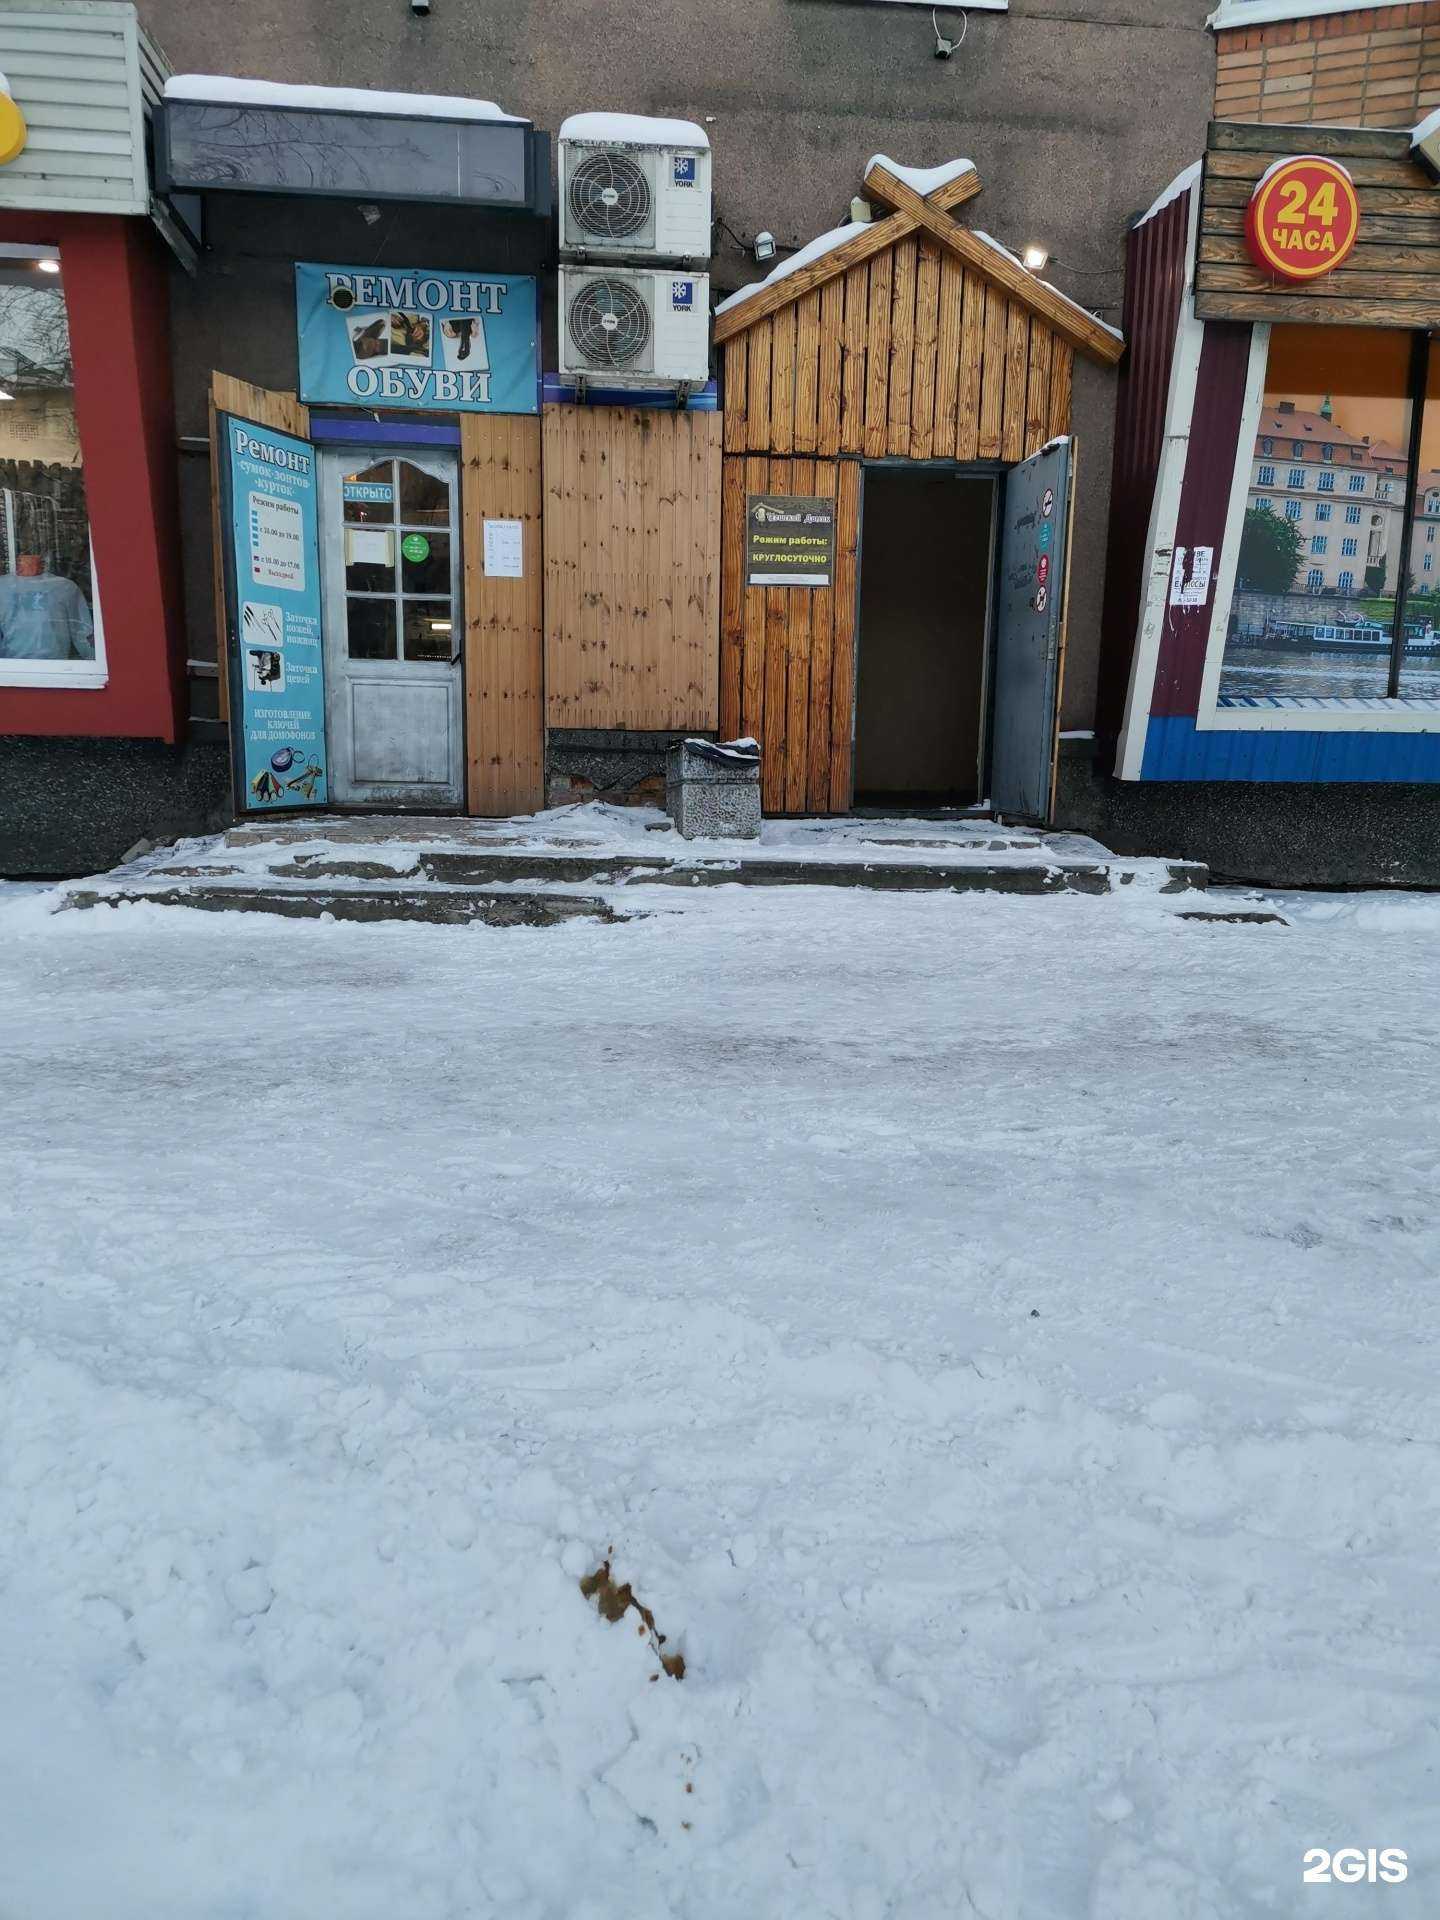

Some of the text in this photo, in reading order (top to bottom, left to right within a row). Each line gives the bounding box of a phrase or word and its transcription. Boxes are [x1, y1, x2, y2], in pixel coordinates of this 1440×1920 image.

[674, 180, 694, 188] YORK
[1277, 180, 1339, 226] 24
[1272, 228, 1336, 252] ЧАСА
[325, 273, 508, 315] РЕМОНТ
[672, 304, 692, 312] YORK
[346, 364, 492, 403] ОБУВИ
[234, 427, 310, 475] Ремонт
[752, 534, 828, 546] Режим работы:
[752, 553, 827, 563] КРУГЛОСУТОЧНО
[254, 708, 312, 720] ИЗГОТОВЛЕНИЕ
